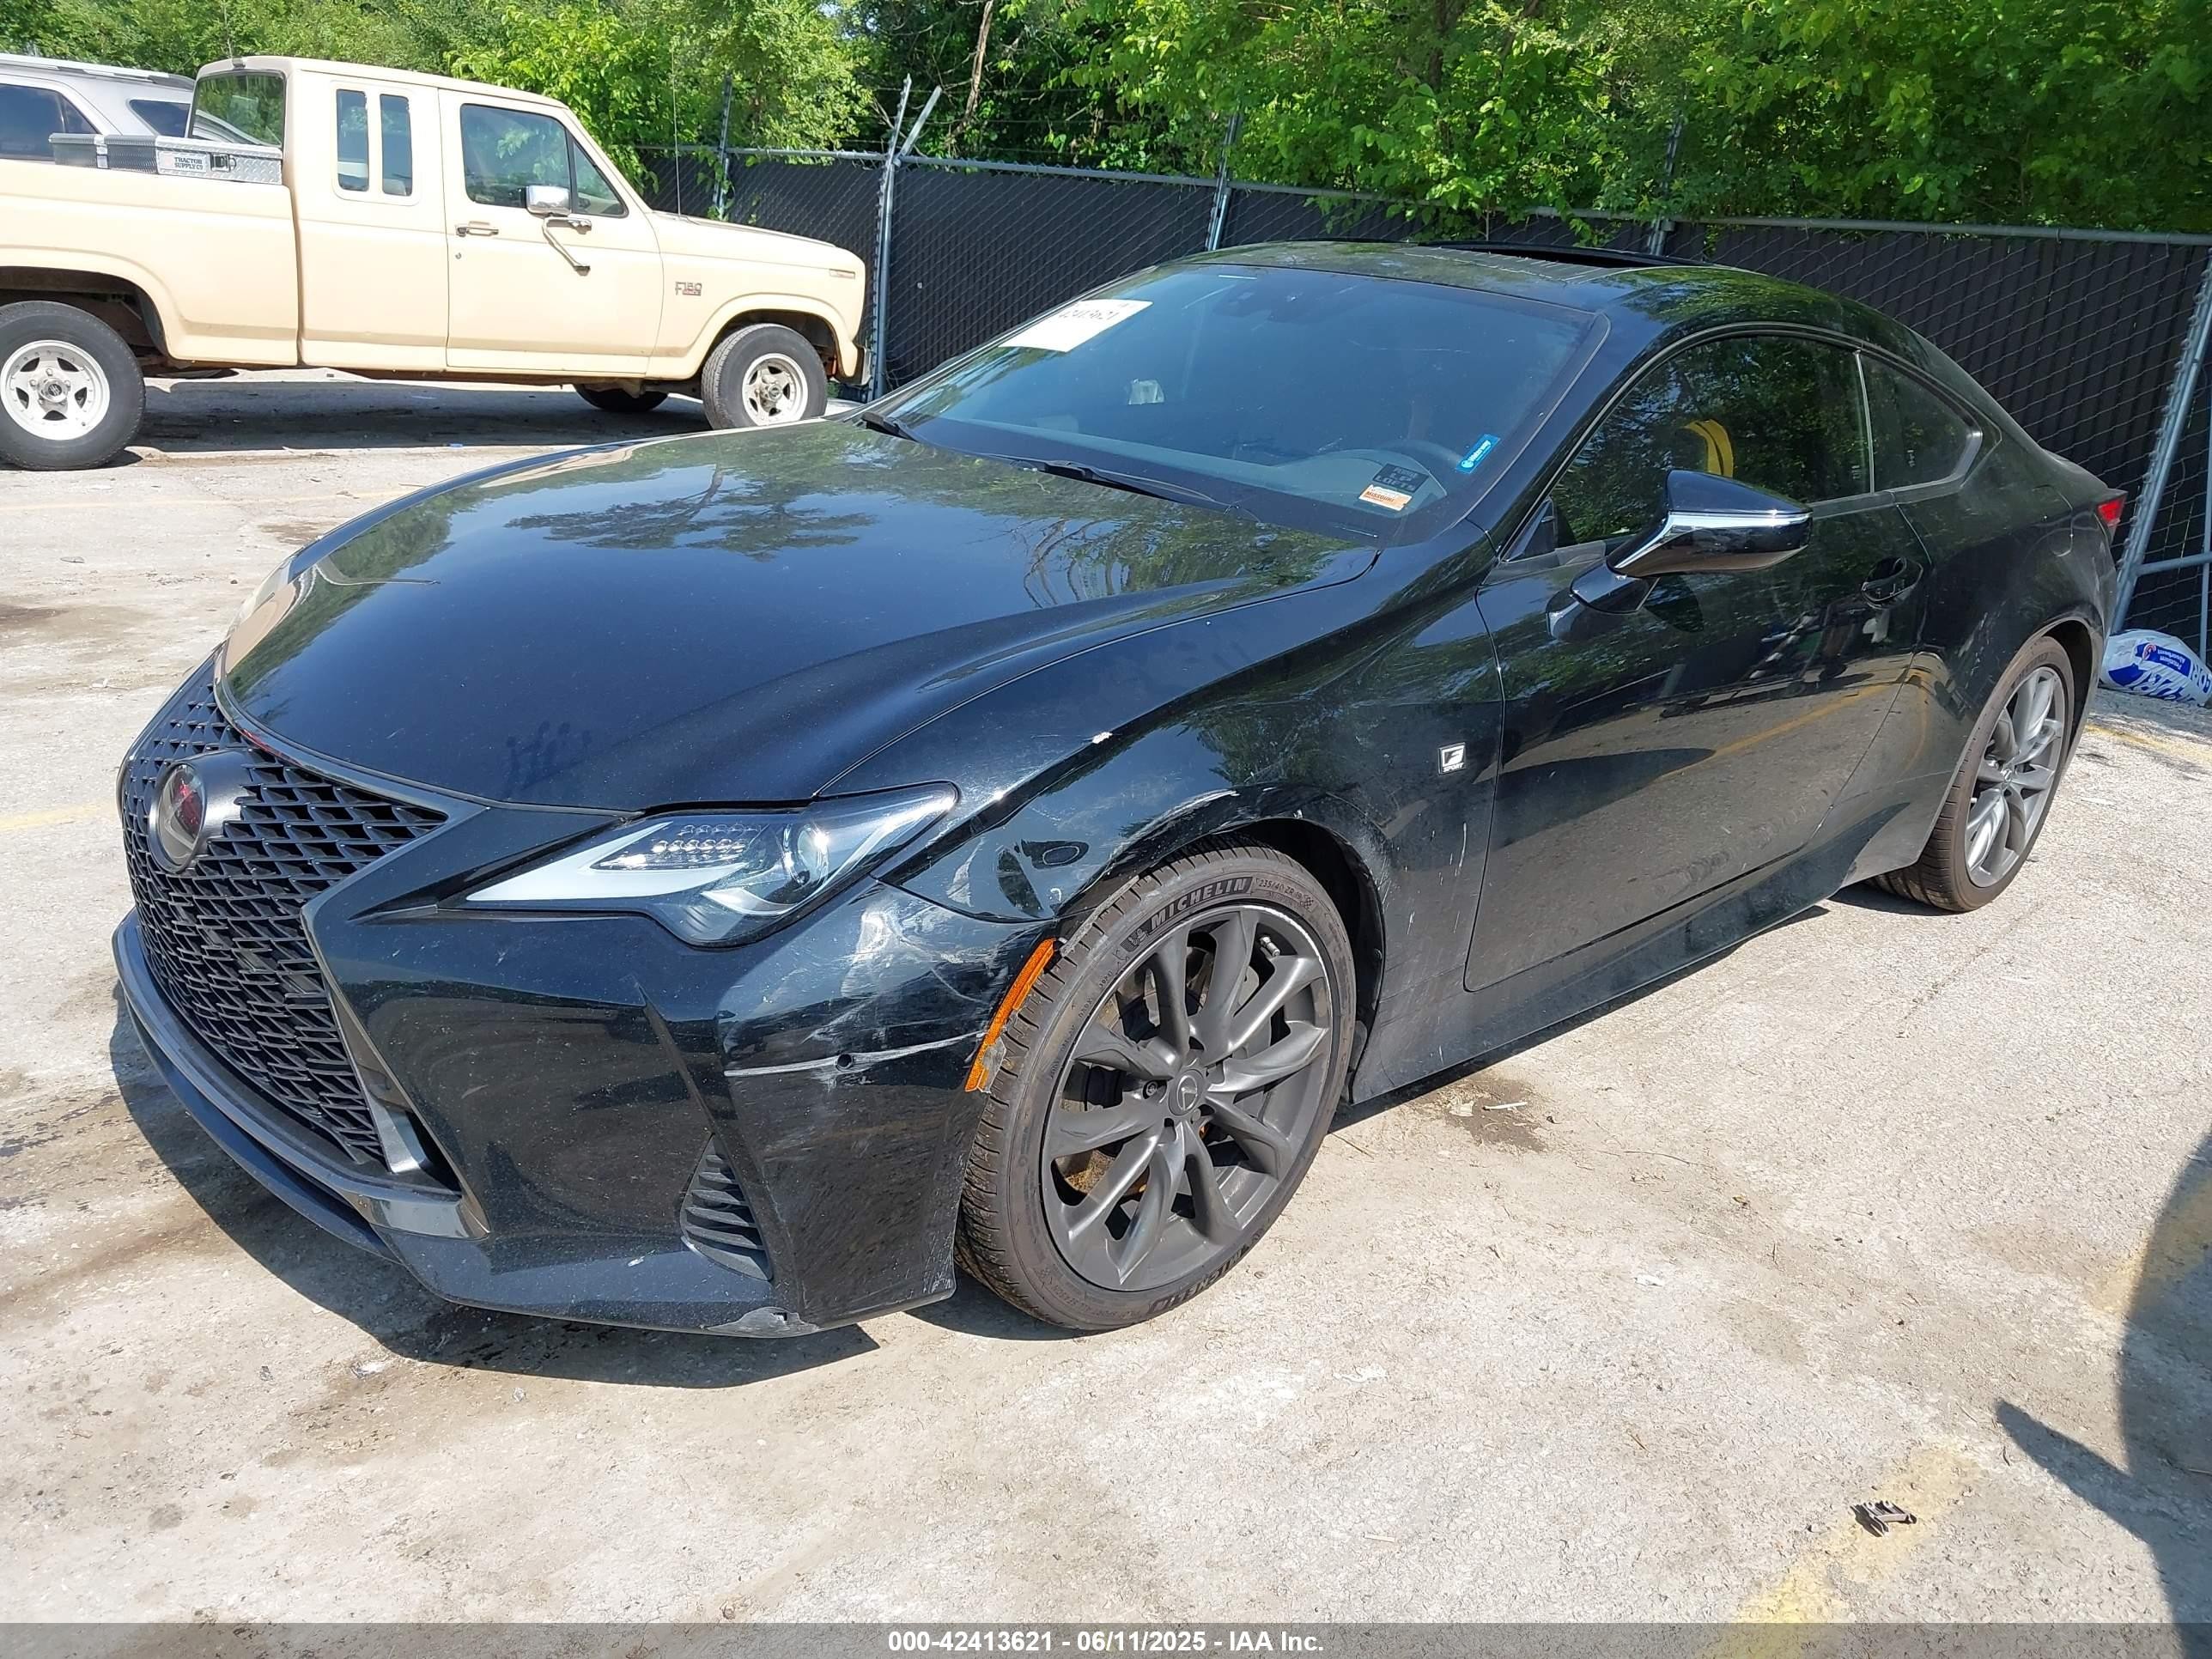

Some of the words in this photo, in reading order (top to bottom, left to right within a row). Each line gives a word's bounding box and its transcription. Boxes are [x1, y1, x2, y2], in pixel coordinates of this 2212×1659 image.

[174, 156, 203, 165] TRACTOR
[1152, 878, 1246, 930] MICHELIN
[1259, 879, 1284, 890] 235/40
